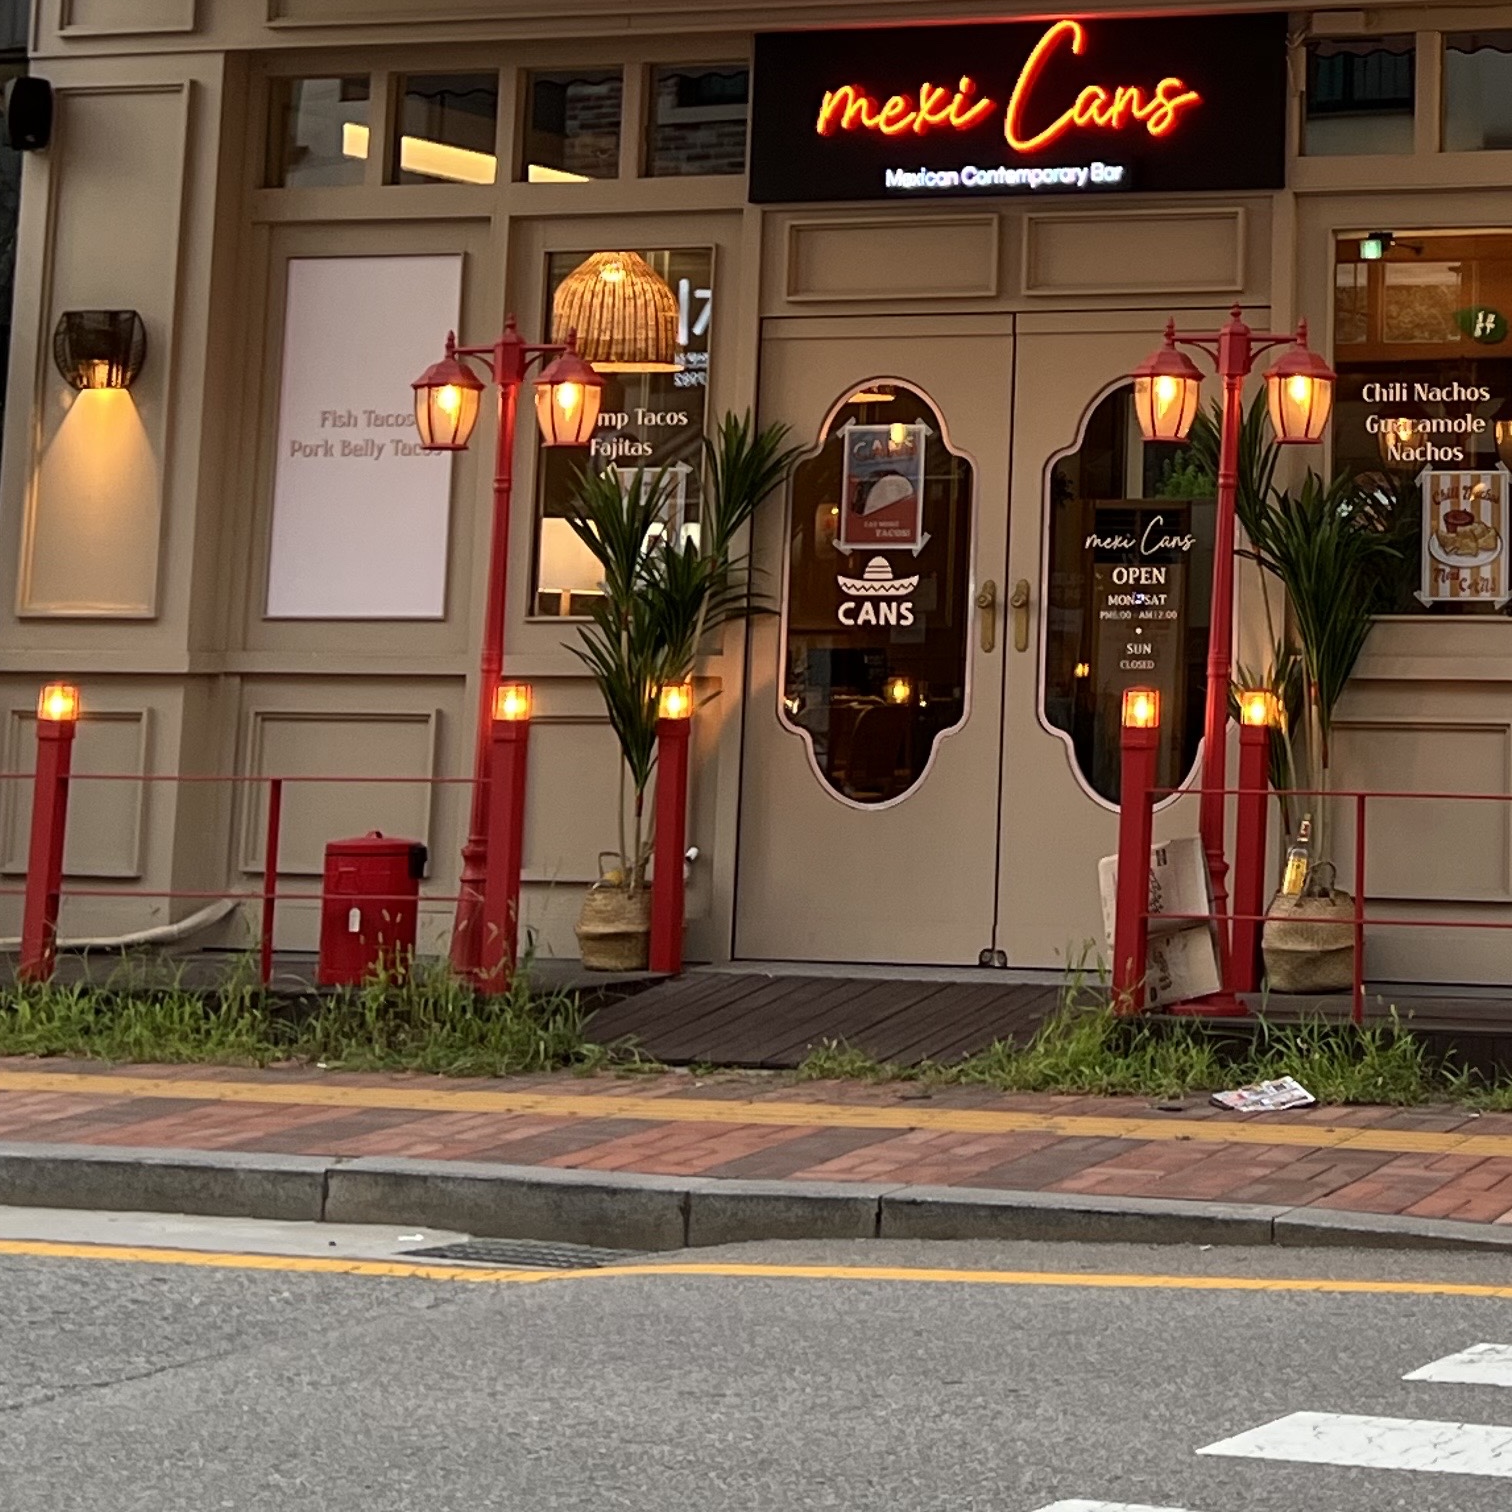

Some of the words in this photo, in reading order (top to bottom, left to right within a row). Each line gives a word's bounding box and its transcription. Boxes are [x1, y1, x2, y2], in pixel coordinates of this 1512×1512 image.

[816, 75, 996, 136] mexi
[1004, 19, 1200, 153] Cans
[885, 168, 959, 188] Mexican
[961, 165, 1089, 189] Contemporary
[1090, 161, 1124, 183] Bar
[1362, 382, 1408, 403] Chili
[1413, 381, 1491, 403] Nachos
[320, 409, 358, 428] Fish
[633, 407, 689, 426] Tacos
[289, 439, 335, 458] Pork
[341, 438, 387, 460] Belly
[590, 437, 654, 460] Fajitas
[1387, 441, 1465, 462] Nachos
[1084, 533, 1136, 551] mexi
[1140, 514, 1196, 556] Cans
[1112, 566, 1167, 585] OPEN
[1107, 593, 1136, 606] MON
[1144, 593, 1168, 606] SAT
[837, 601, 915, 626] CANS
[1126, 643, 1152, 655] SUN
[1120, 659, 1155, 670] CLOSED
